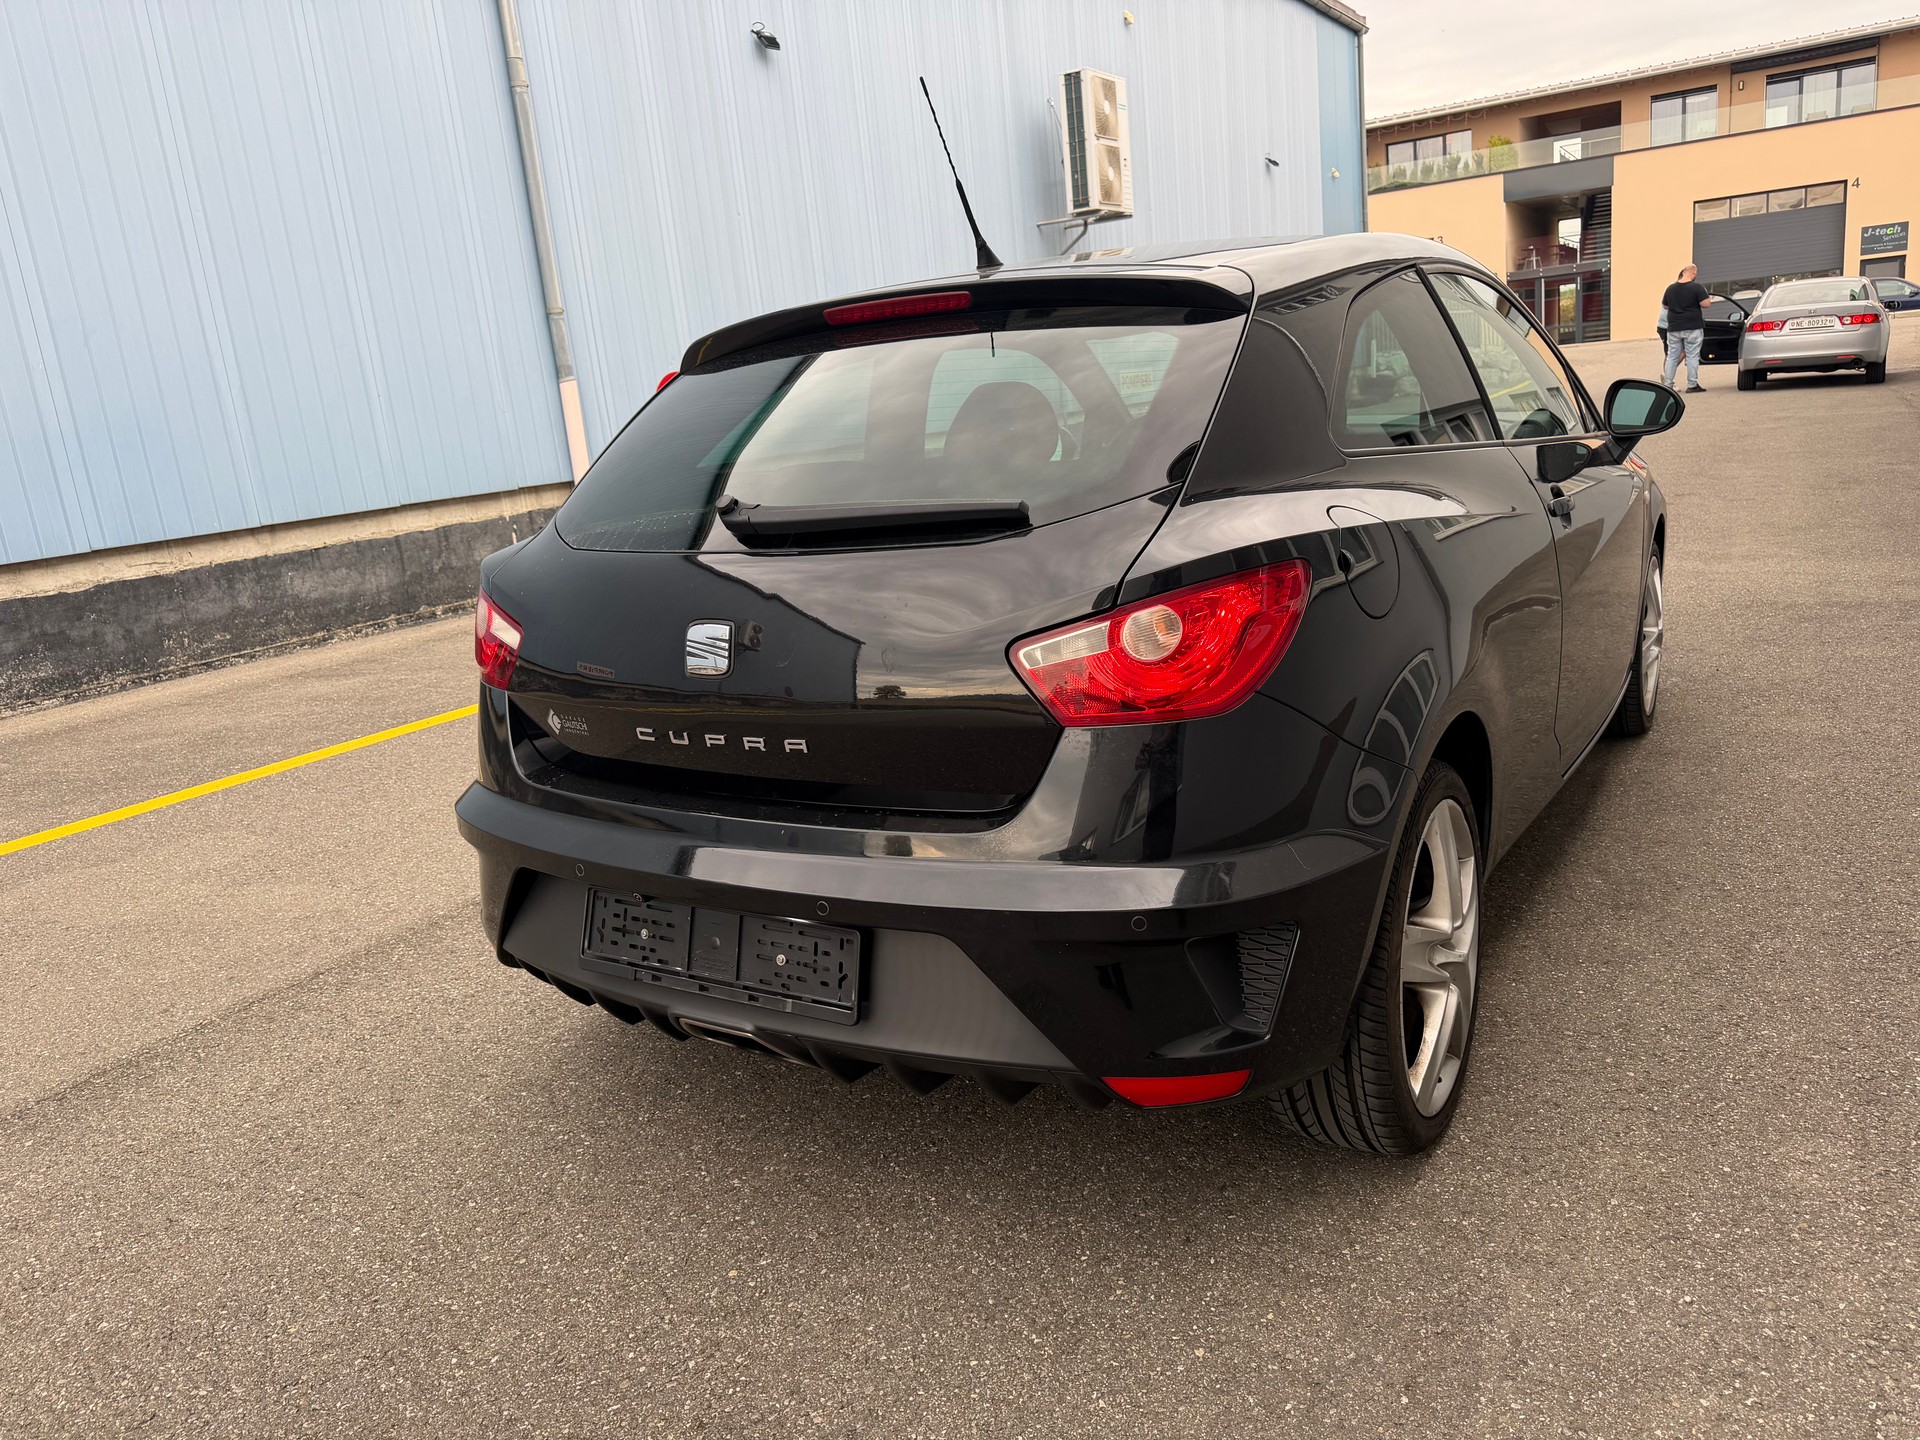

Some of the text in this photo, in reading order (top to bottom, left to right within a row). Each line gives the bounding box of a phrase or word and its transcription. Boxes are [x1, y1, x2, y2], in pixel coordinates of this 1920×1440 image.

[1851, 177, 1860, 188] 4
[1864, 225, 1901, 237] J-tech
[635, 727, 808, 754] CUPRA
